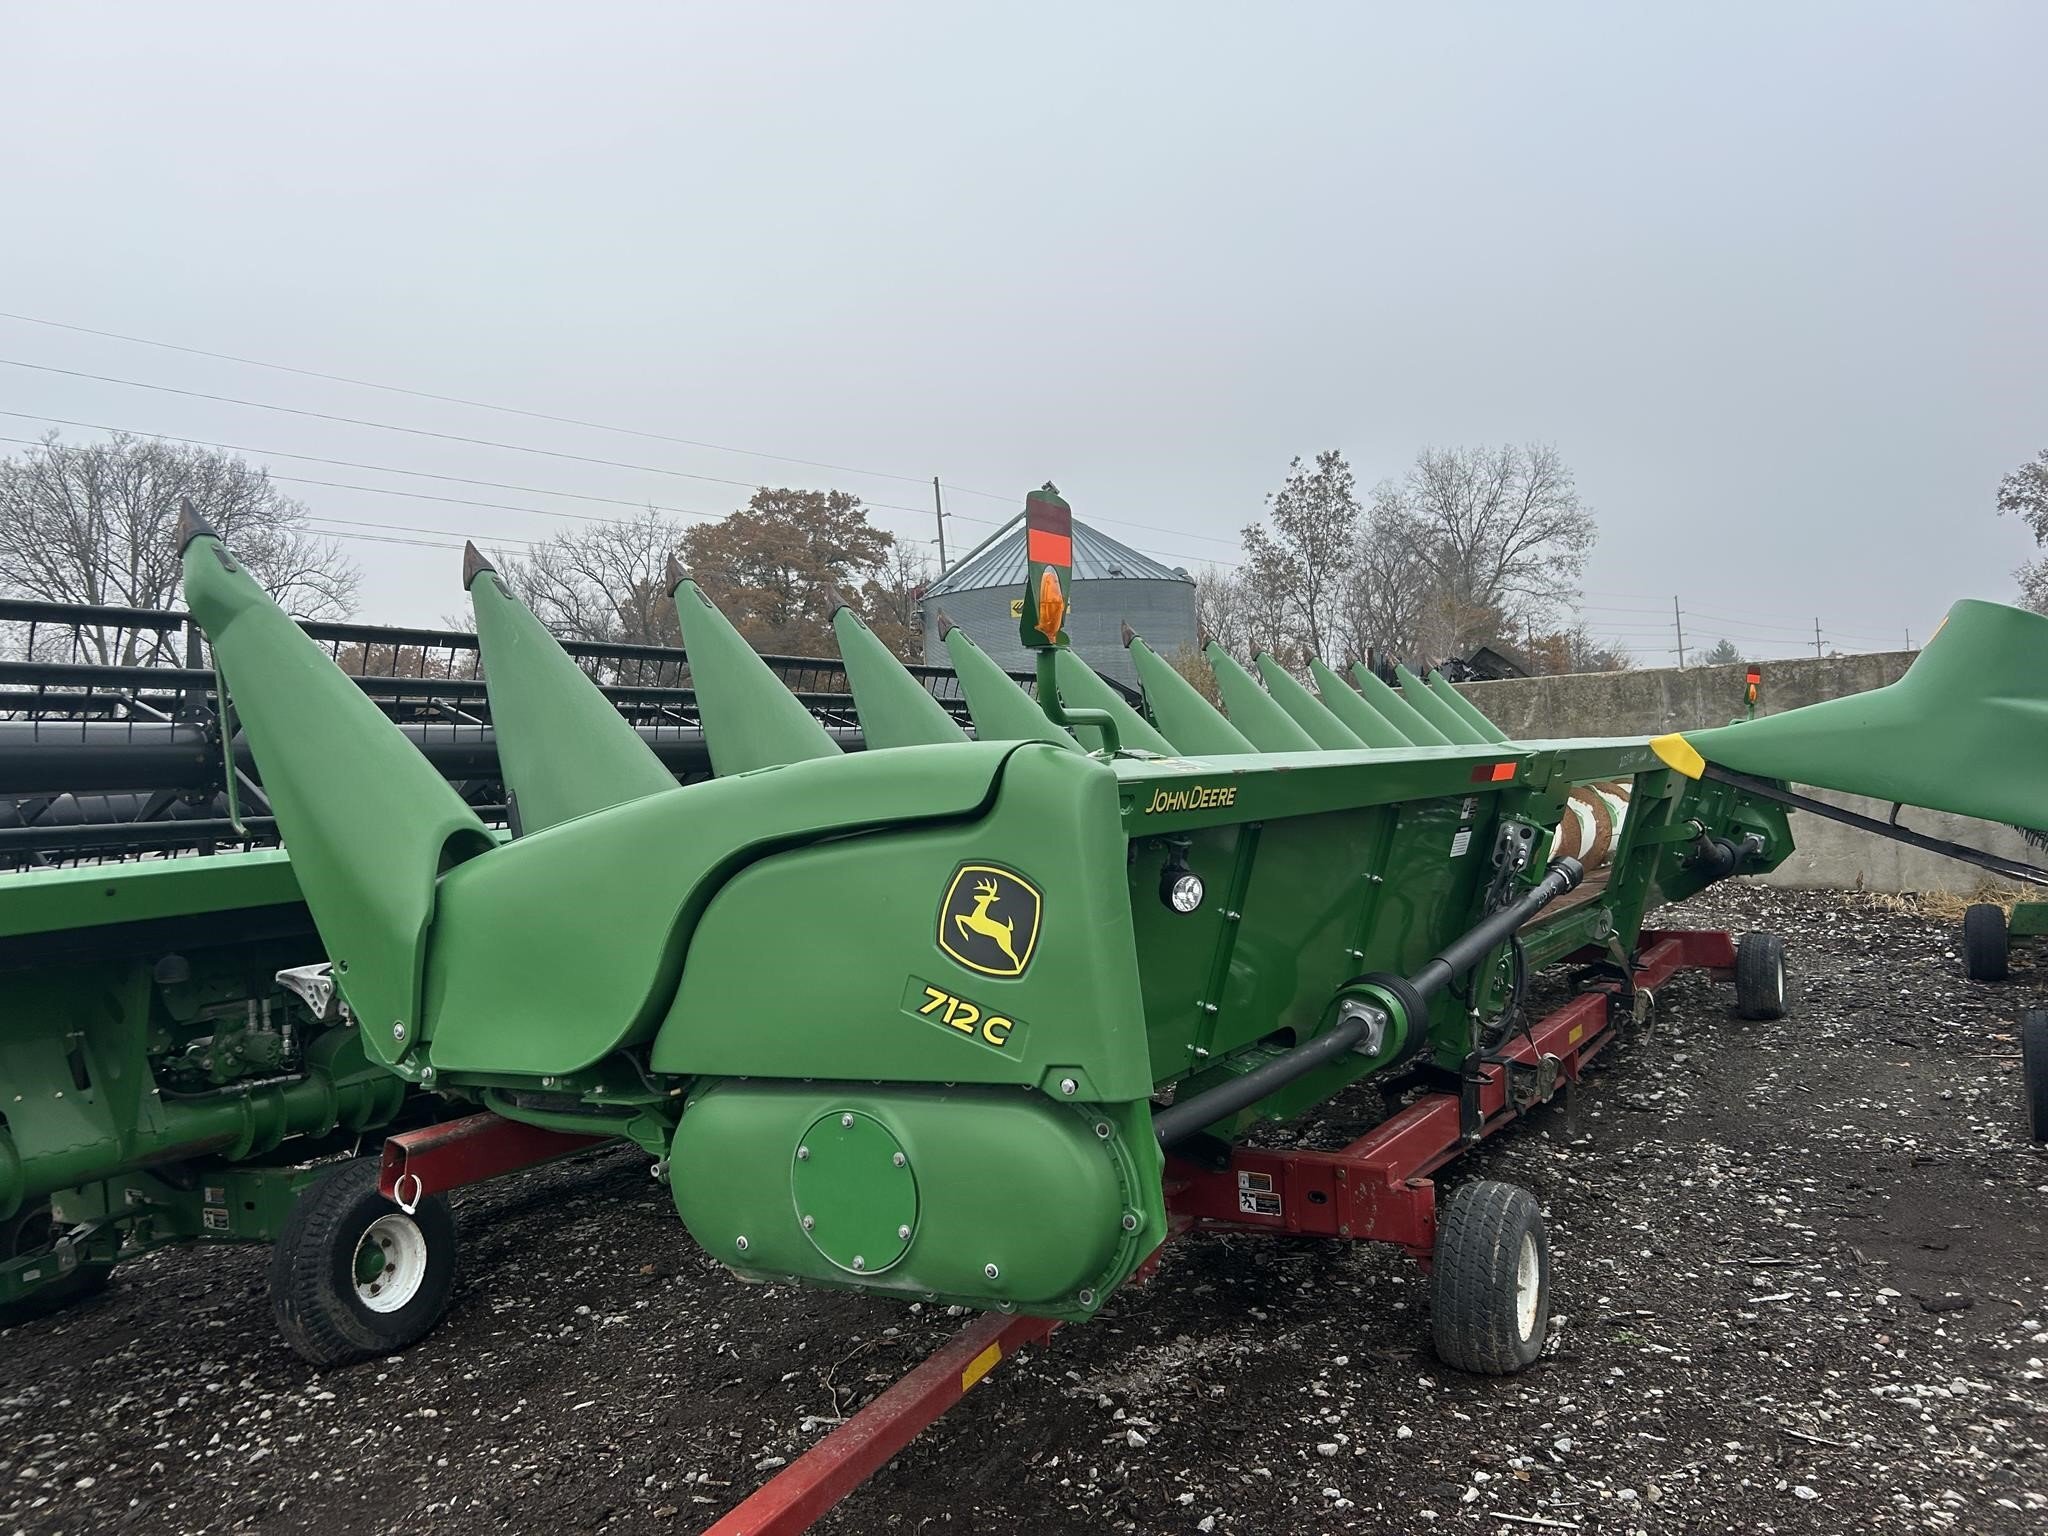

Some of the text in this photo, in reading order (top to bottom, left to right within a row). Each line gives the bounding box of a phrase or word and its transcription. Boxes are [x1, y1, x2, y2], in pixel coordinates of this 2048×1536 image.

[1145, 785, 1237, 814] JOHN DEERE
[918, 985, 1014, 1046] 712 C
